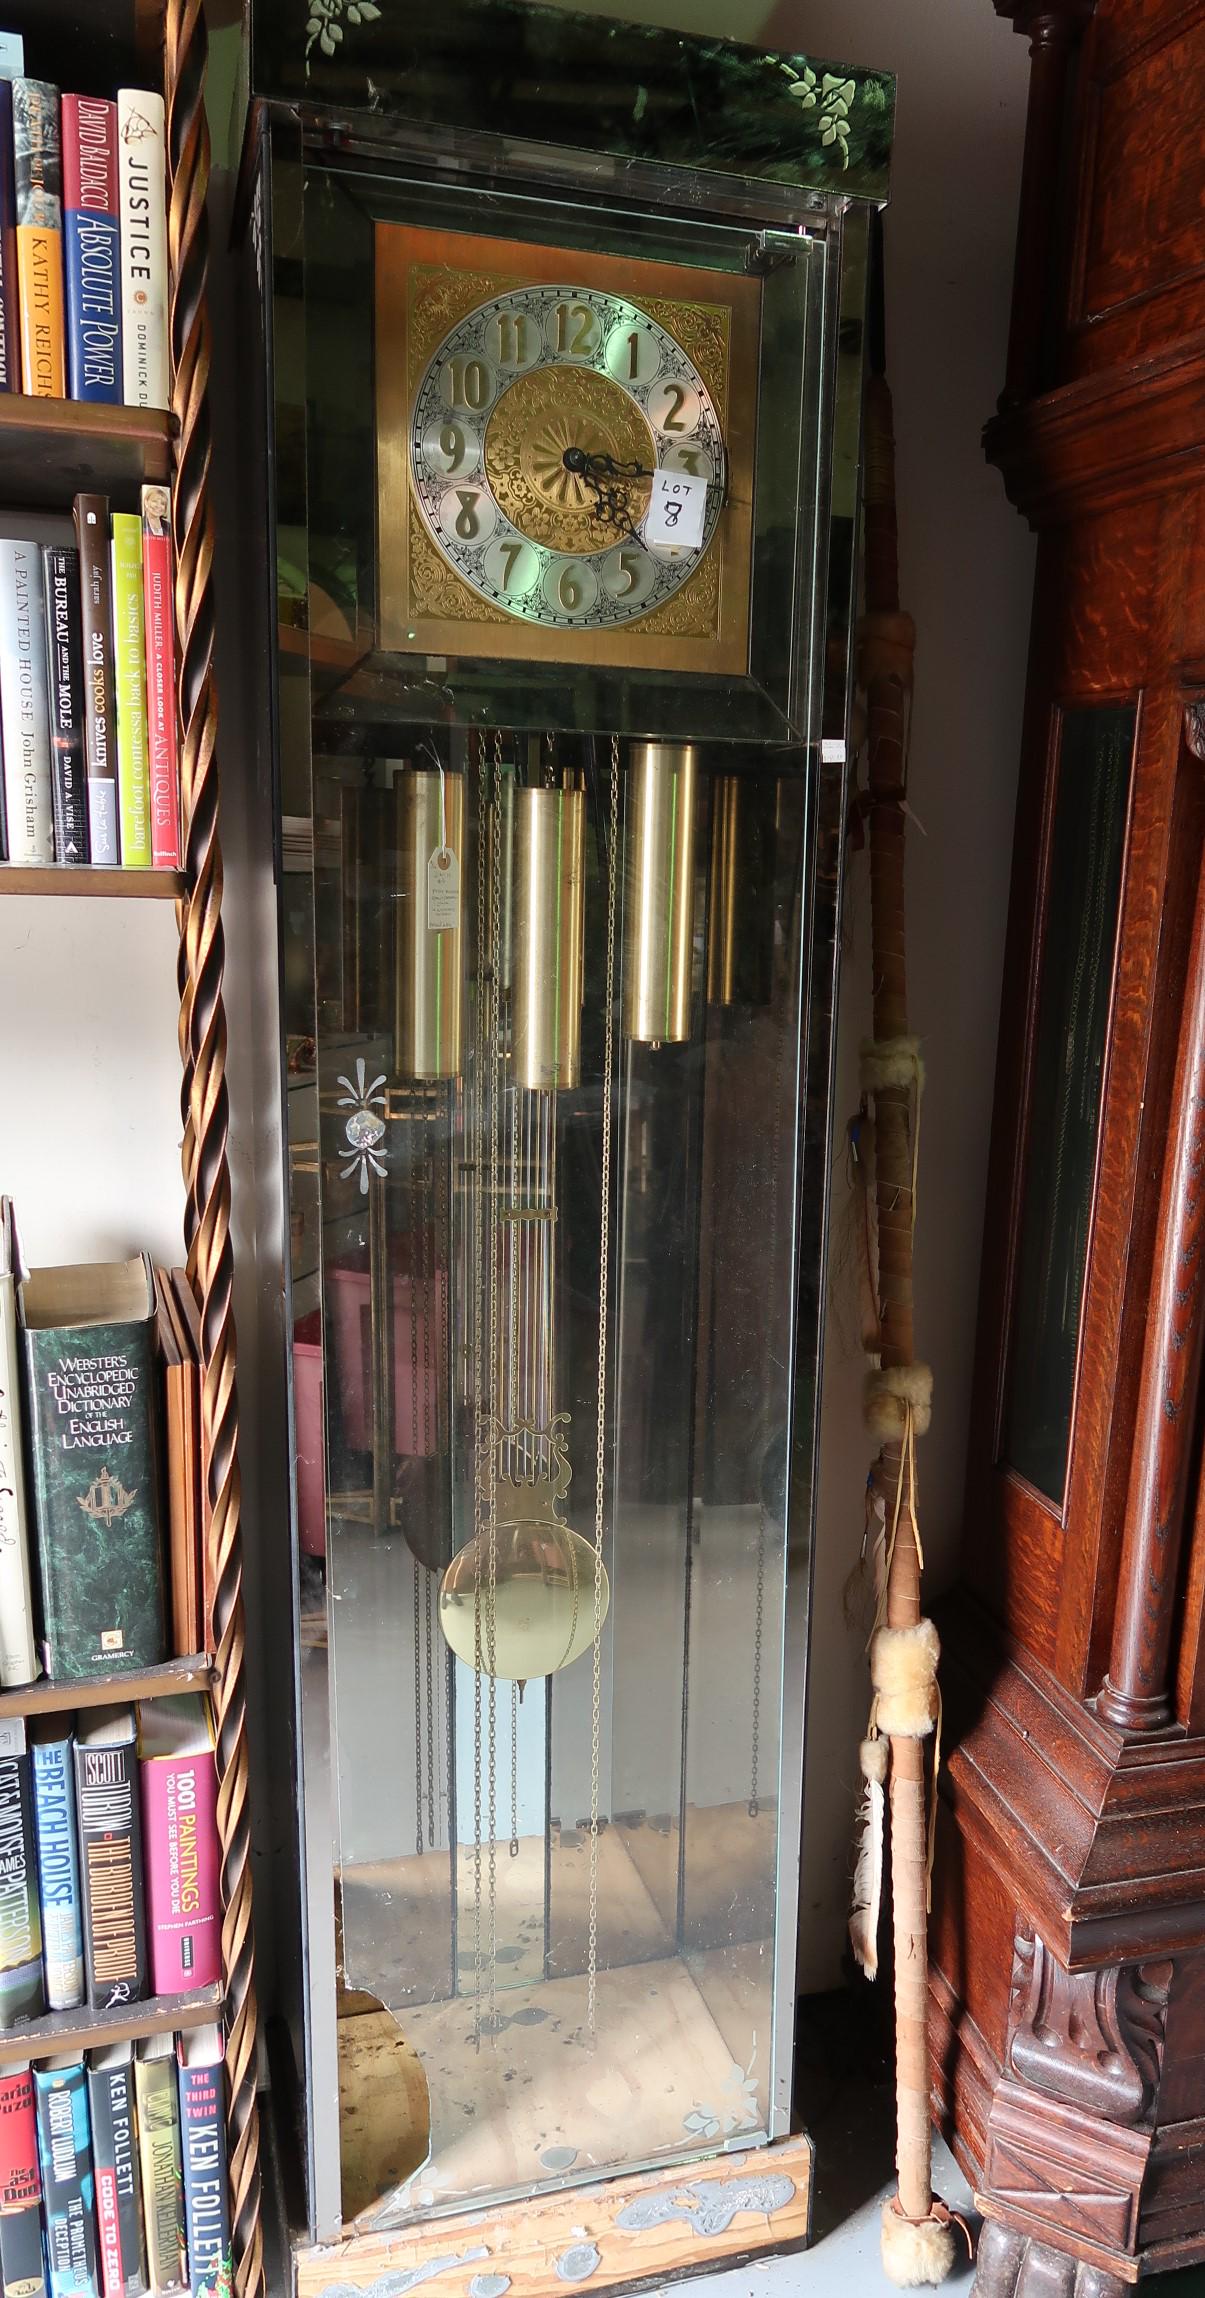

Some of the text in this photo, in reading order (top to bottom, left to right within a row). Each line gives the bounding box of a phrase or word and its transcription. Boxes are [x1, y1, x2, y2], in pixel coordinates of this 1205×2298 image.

[78, 100, 111, 211] DAVID BALDACCI
[128, 157, 151, 280] JUSTICE
[32, 237, 51, 314] KATHY
[77, 213, 119, 386] ABSOLUTE POWER
[498, 313, 526, 364] 11
[554, 303, 594, 357] 12
[137, 324, 148, 387] DOMINICK
[627, 331, 639, 380] 1
[447, 358, 489, 412] 10
[662, 384, 688, 433] 2
[438, 423, 465, 474] 9
[661, 479, 693, 496] LOT
[454, 489, 481, 541] 8
[663, 500, 683, 528] 8
[90, 564, 104, 605] sarah jay
[152, 571, 162, 610] JUDITH
[498, 542, 524, 592] 7
[557, 565, 577, 611] 6
[614, 551, 641, 599] 5
[14, 551, 34, 722] A PAINTED HOUSE
[54, 556, 73, 730] THE BUREAU AND THE MOLE
[123, 592, 140, 644] basics
[127, 647, 140, 665] to
[155, 662, 165, 698] CLOSER
[87, 631, 108, 768] love cooks knives
[125, 669, 143, 708] back
[157, 699, 165, 722] LOOK
[21, 731, 36, 769] John
[130, 711, 145, 781] contessa
[158, 721, 165, 732] AT
[63, 755, 75, 831] DAVID A. VISE
[153, 733, 171, 826] ANTIQUES
[24, 772, 37, 839] Grisham
[94, 790, 110, 855] Sur la table
[128, 783, 146, 851] barefoot
[153, 850, 177, 858] Bulfinch
[47, 1367, 140, 1387] ENCYCLOPEDIC
[58, 1355, 128, 1372] WEBSTER'S
[54, 1381, 136, 1400] UNABRIDGED
[58, 1395, 133, 1414] DICTIONARY
[95, 1410, 108, 1419] THE
[62, 1430, 134, 1449] LANGUAGE
[70, 1418, 124, 1435] ENGLISH
[91, 1650, 135, 1662] GRAMERCY
[36, 1749, 63, 1766] THE
[87, 1751, 122, 1785] SCOTT
[81, 1780, 133, 1833] TUROW
[37, 1766, 74, 1907] BEACH HOUSE
[166, 1772, 181, 1916] YOU MUST SEE BEFORE YOU DIE
[176, 1769, 200, 1913] 1001 PAINTINGS
[0, 1852, 33, 1963] AMES PATTERSON
[87, 1835, 137, 1982] THE BURDEN OF PROOF
[157, 1914, 215, 1931] STEPHEN FARTHING
[183, 1936, 192, 1968] UNIVERSE
[1, 2083, 31, 2102] ario
[186, 2087, 216, 2103] THIRD
[191, 2072, 210, 2086] THE
[0, 2097, 32, 2114] uzo
[186, 2103, 218, 2119] TWIN
[48, 2089, 77, 2183] ROBERT LUDLUM
[110, 2072, 135, 2197] KEN FOLLETT
[4, 2184, 37, 2202] Don
[152, 2140, 178, 2201] JONATHAN
[189, 2122, 224, 2276] KEN FOLLETT
[54, 2217, 71, 2274] DECEPTION
[67, 2196, 90, 2288] THE PROMETHEUS
[101, 2174, 121, 2292] CODE TO ZERO
[156, 2200, 180, 2273] KELLERMAN
